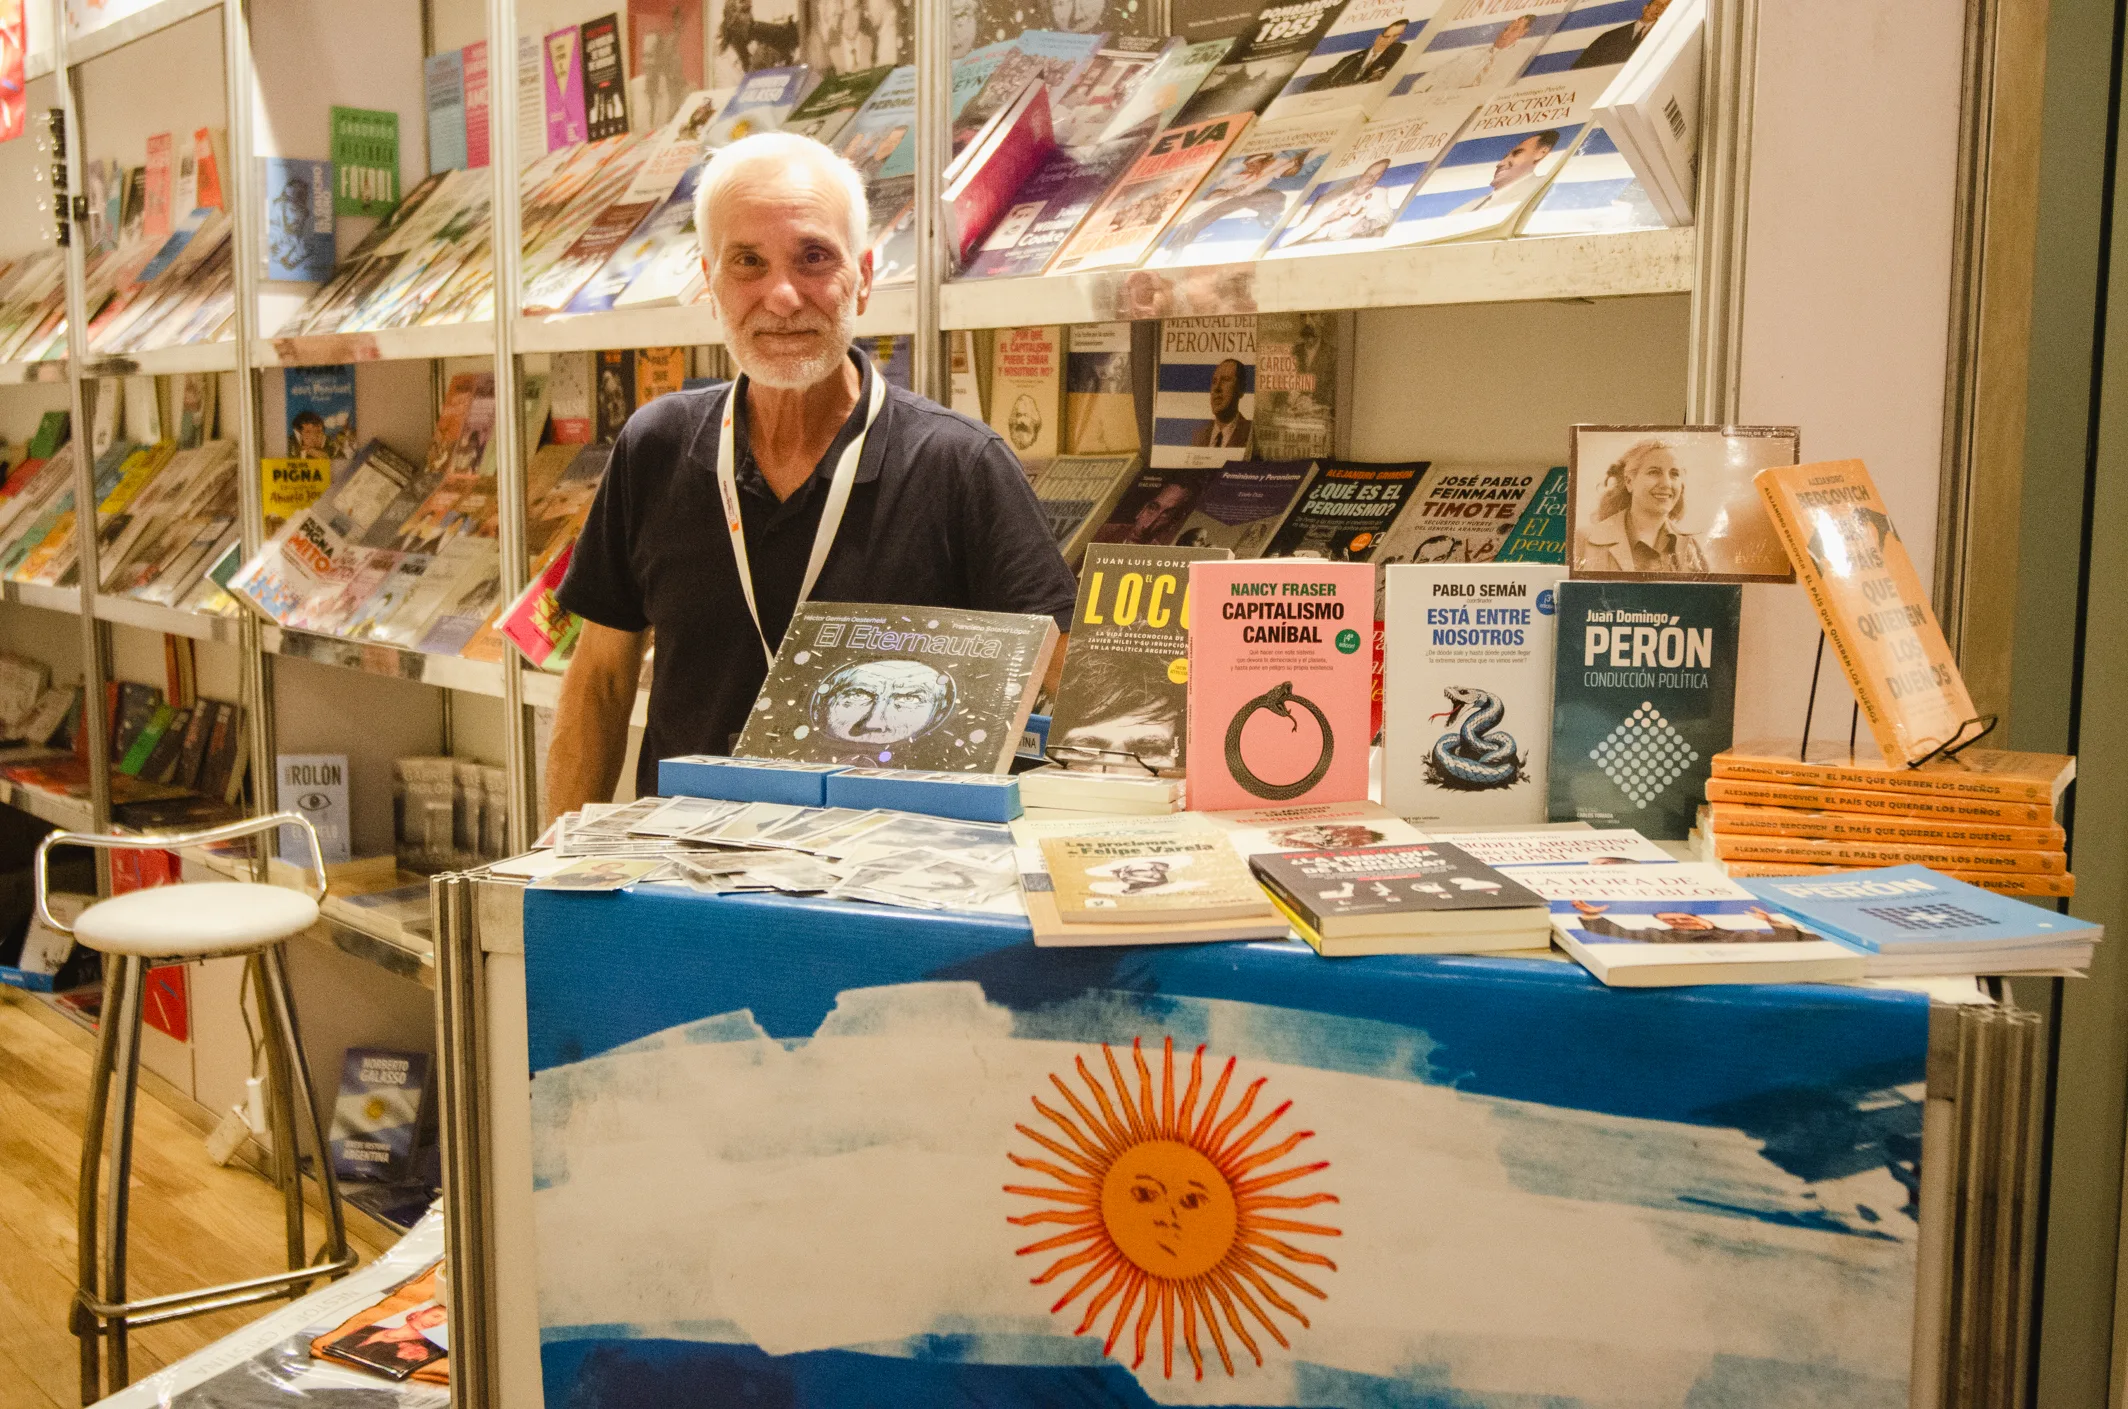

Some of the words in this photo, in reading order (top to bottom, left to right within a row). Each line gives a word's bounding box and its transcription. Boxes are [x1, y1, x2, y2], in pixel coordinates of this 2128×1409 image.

[1255, 13, 1324, 42] 1955
[1482, 91, 1576, 115] DOCTRINA
[1473, 106, 1571, 132] PERONISTA
[1148, 121, 1230, 157] EVA
[1395, 133, 1448, 155] MILITAR
[1018, 231, 1066, 247] Cooke
[1165, 332, 1257, 352] PERONISTA
[1259, 356, 1297, 372] CARLOS
[273, 469, 323, 482] PIGNA
[1326, 470, 1376, 479] ALEJANDRO
[1437, 475, 1479, 486] JOSÉ
[1480, 477, 1533, 486] PABLO
[1309, 482, 1357, 500] ¿QUÉ
[1356, 485, 1379, 499] ES
[1382, 484, 1403, 499] EL
[1429, 488, 1526, 500] FEINMANN
[1796, 484, 1870, 507] BERCOVICH
[1302, 501, 1396, 516] PERONISMO?
[1421, 502, 1516, 519] TIMOTE
[1522, 518, 1548, 537] El
[300, 521, 336, 559] PIGNA
[1096, 557, 1124, 565] JUAN
[1145, 575, 1153, 583] EL
[1231, 583, 1277, 596] NANCY
[1282, 583, 1336, 596] FRASER
[1433, 584, 1475, 596] PABLO
[1479, 581, 1527, 596] SEMÁN
[1861, 578, 1898, 606] QUE
[1222, 602, 1344, 620] CAPITALISMO
[1427, 604, 1470, 625] ESTÁ
[1476, 609, 1530, 625] ENTRE
[1764, 487, 1787, 530] ALEJANDRO
[1785, 529, 1806, 570] BERCOVICH
[1805, 574, 1813, 586] EL
[1811, 587, 1825, 609] PAÍS
[1822, 610, 1834, 628] QUE
[1830, 628, 1852, 667] QUIEREN
[1849, 668, 1862, 686] LOS
[1858, 687, 1880, 724] DUEÑOS
[1586, 609, 1613, 623] Juan
[1616, 610, 1668, 626] Domingo
[1857, 604, 1928, 641] QUIEREN
[1243, 621, 1322, 643] CANÍBAL
[1432, 629, 1525, 646] NOSOTROS
[814, 624, 846, 647] El
[846, 624, 1002, 659] Eternauta
[1584, 616, 1713, 669] PERÓN
[1889, 636, 1921, 663] LOS
[1145, 648, 1185, 656] ARGENTINA
[1584, 669, 1655, 688] CONDUCCIÓN
[1658, 671, 1708, 688] POLÍTICA
[1885, 663, 1953, 700] DUEÑOS
[291, 763, 342, 785] ROLÓN
[1841, 774, 1862, 782] PAÍS
[1889, 778, 1932, 788] QUIEREN
[1958, 783, 2000, 794] DUEÑOS
[1724, 789, 1770, 798] ALEJANDRO
[1773, 793, 1818, 802] BERCOVICH
[1840, 797, 1861, 805] PAÍS
[1889, 802, 1933, 811] QUIEREN
[1936, 805, 1955, 813] LOS
[1958, 806, 2001, 817] DUEÑOS
[1834, 825, 1845, 833] EL
[1849, 825, 1871, 833] PAÍS
[1875, 828, 1895, 836] QUE
[1899, 829, 1943, 838] QUIEREN
[1947, 831, 1966, 839] LOS
[1969, 832, 2012, 841] DUEÑOS
[1080, 847, 1142, 856] Felipe
[1149, 843, 1215, 853] Varela
[1097, 839, 1177, 847] proclamas
[1456, 841, 1532, 849] MODELO
[1538, 838, 1639, 848] ARGENTINO
[1524, 846, 1626, 854] PROYECTO
[1478, 854, 1574, 862] NACIONAL
[1525, 878, 1563, 886] LA
[1568, 876, 1652, 886] HORA
[1657, 876, 1699, 886] DE
[1770, 878, 1938, 899] PERÓN
[1537, 888, 1592, 897] LOS
[1600, 887, 1732, 897] PUEBLOS
